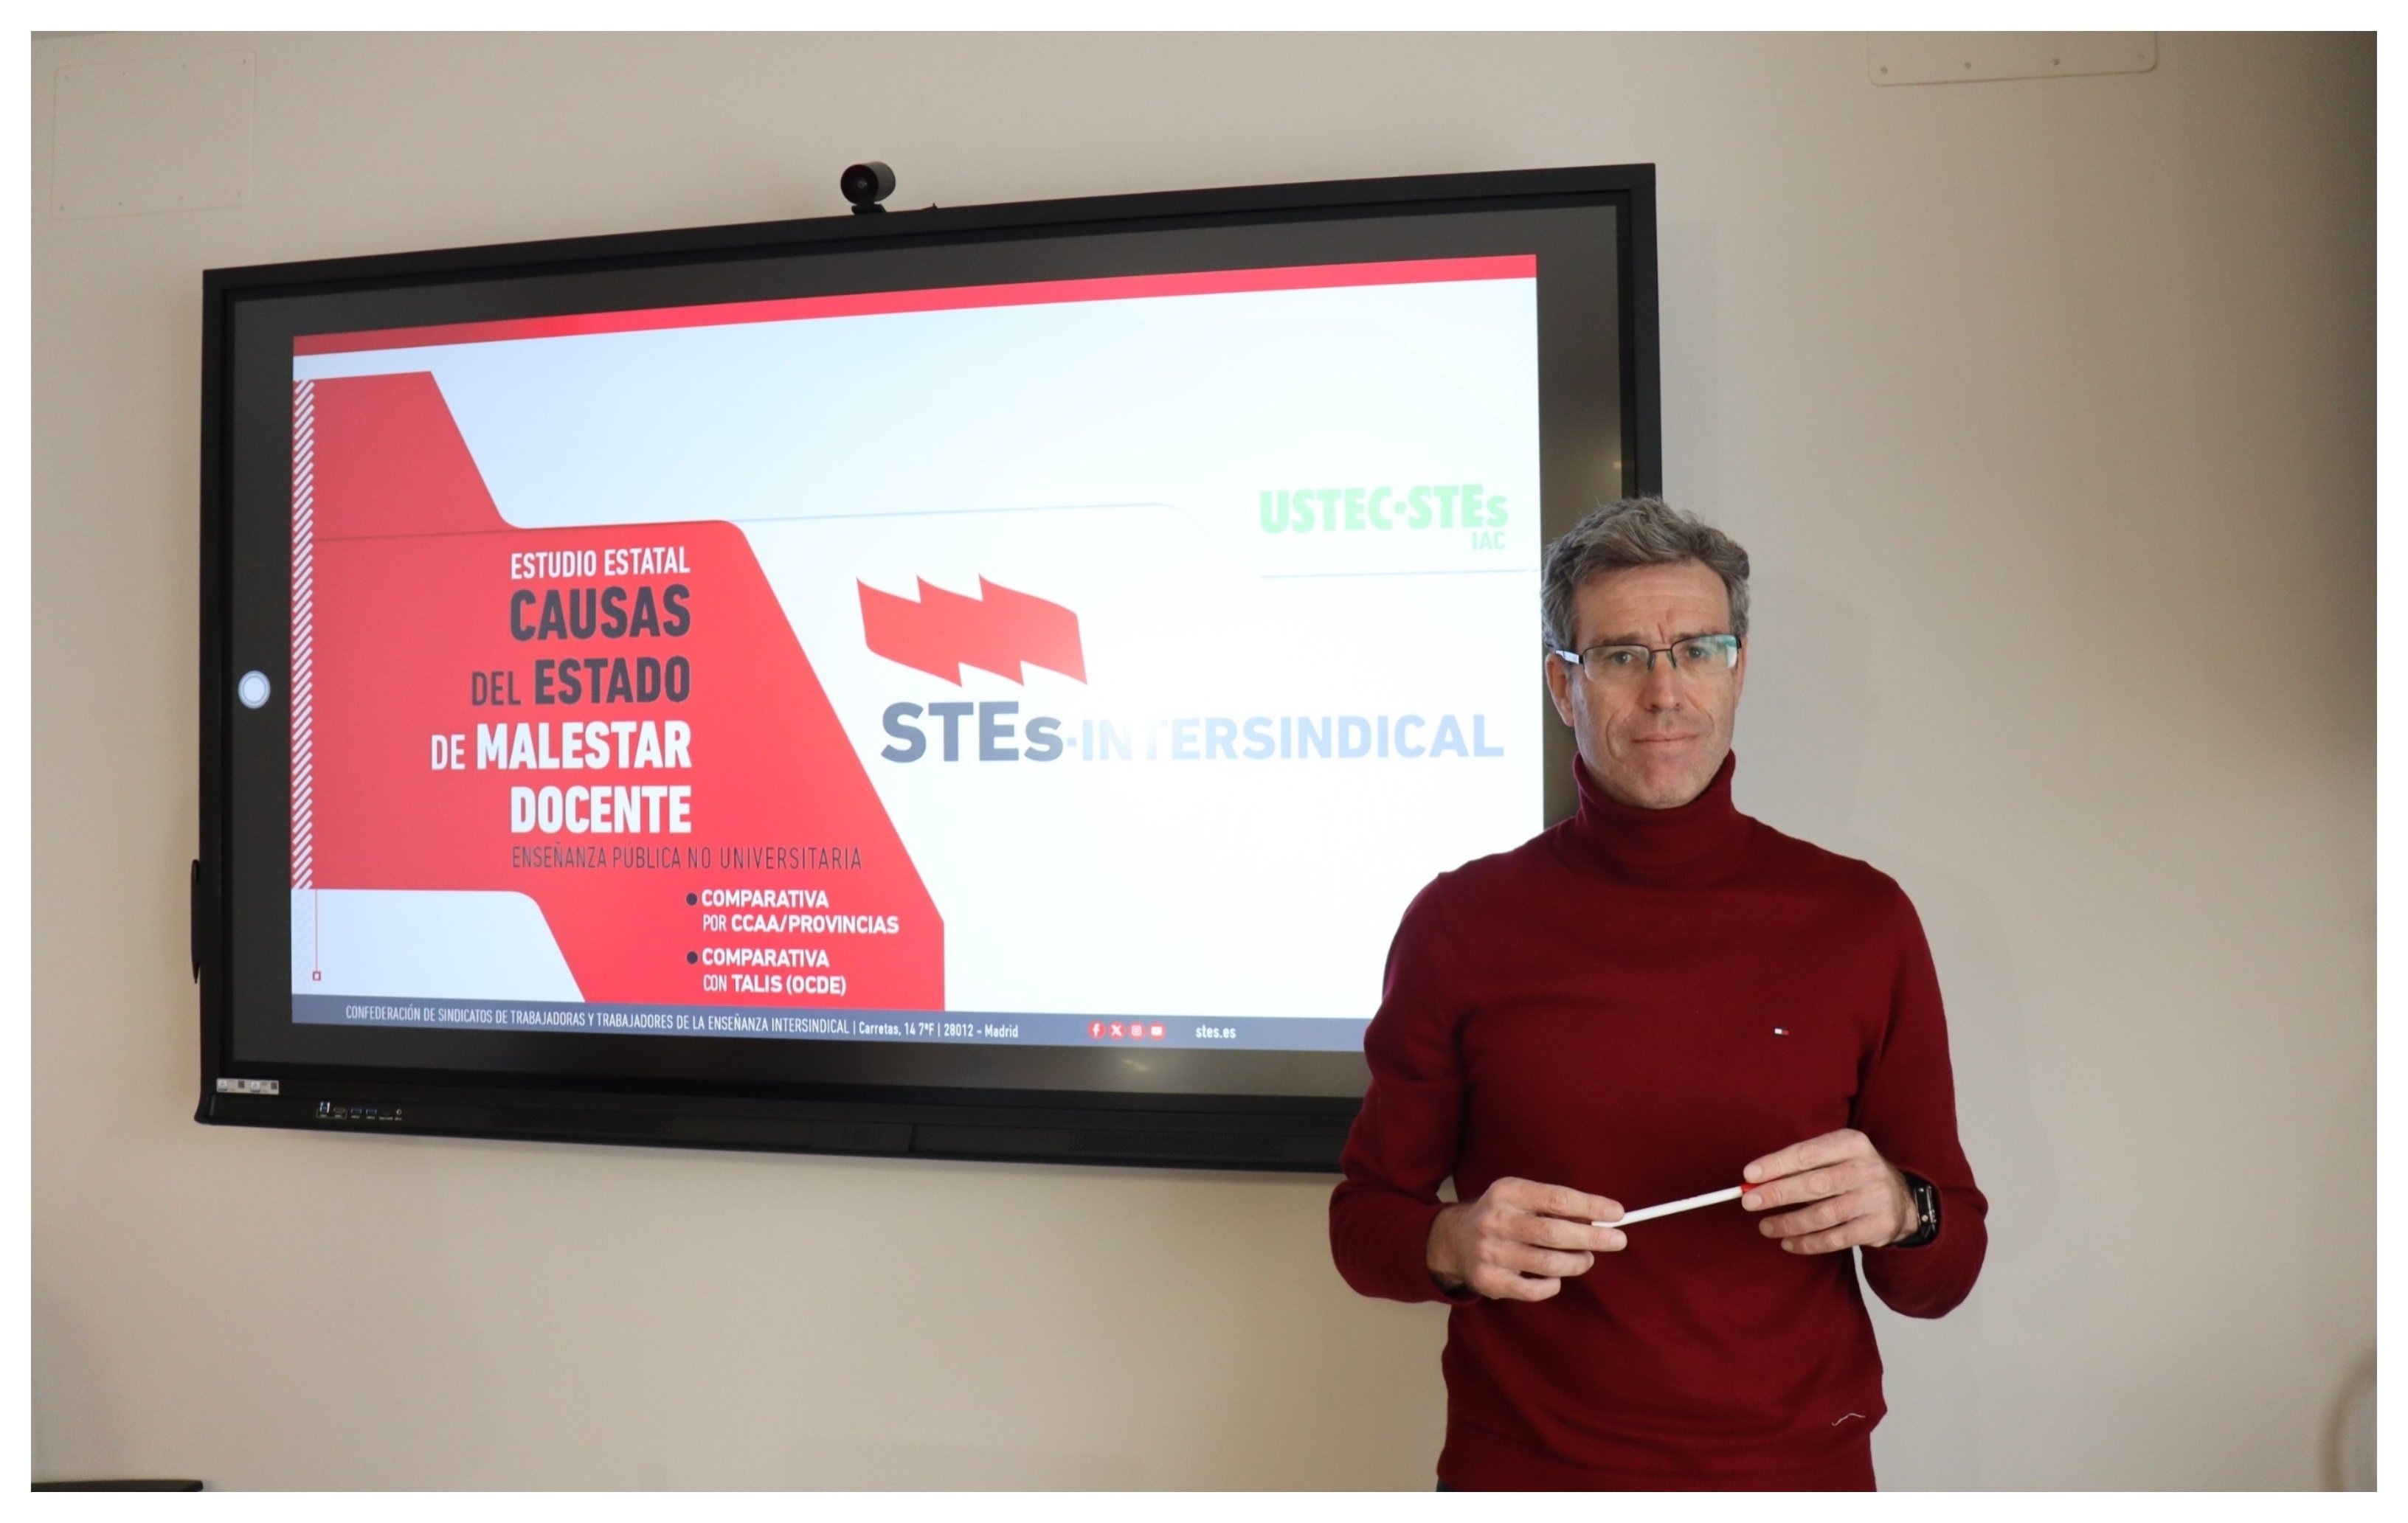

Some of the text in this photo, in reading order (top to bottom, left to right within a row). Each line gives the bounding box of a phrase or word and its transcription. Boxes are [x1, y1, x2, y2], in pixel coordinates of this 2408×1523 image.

[1472, 531, 1506, 550] IAC
[511, 547, 691, 580] ESTUDIO ESTATAL
[511, 583, 691, 641] CAUSAS
[471, 656, 691, 706] DEL ESTADO
[432, 721, 691, 770] DE MALESTAR
[511, 785, 691, 833] DOCENTE
[512, 841, 862, 870] ENSEÑANZA PÚBLICA NO UNIVERSITARIA
[702, 889, 829, 908] COMPARATIVA
[703, 914, 899, 934] POR CCAA/PROVINCIAS
[702, 948, 829, 968] COMPARATIVA
[703, 974, 846, 996] CON TALIS (OCDE)
[345, 1004, 421, 1021] CONFEDERACIÓN
[423, 1008, 436, 1021] DE
[438, 1008, 493, 1023] SINDICATOS
[496, 1010, 508, 1024] DE
[511, 1010, 585, 1026] TRABAJADORAS
[588, 1013, 595, 1026] Y
[596, 1013, 673, 1029] TRABAJADORES
[677, 1015, 689, 1030] DE
[693, 1016, 705, 1030] LA
[708, 1013, 768, 1032] ENSEÑANZA
[772, 1017, 849, 1034] INTERSINDICAL
[904, 1022, 916, 1035] 14
[944, 1023, 974, 1037] 28012
[984, 1024, 1018, 1038] Madrid
[1195, 1024, 1236, 1038] stes.es
